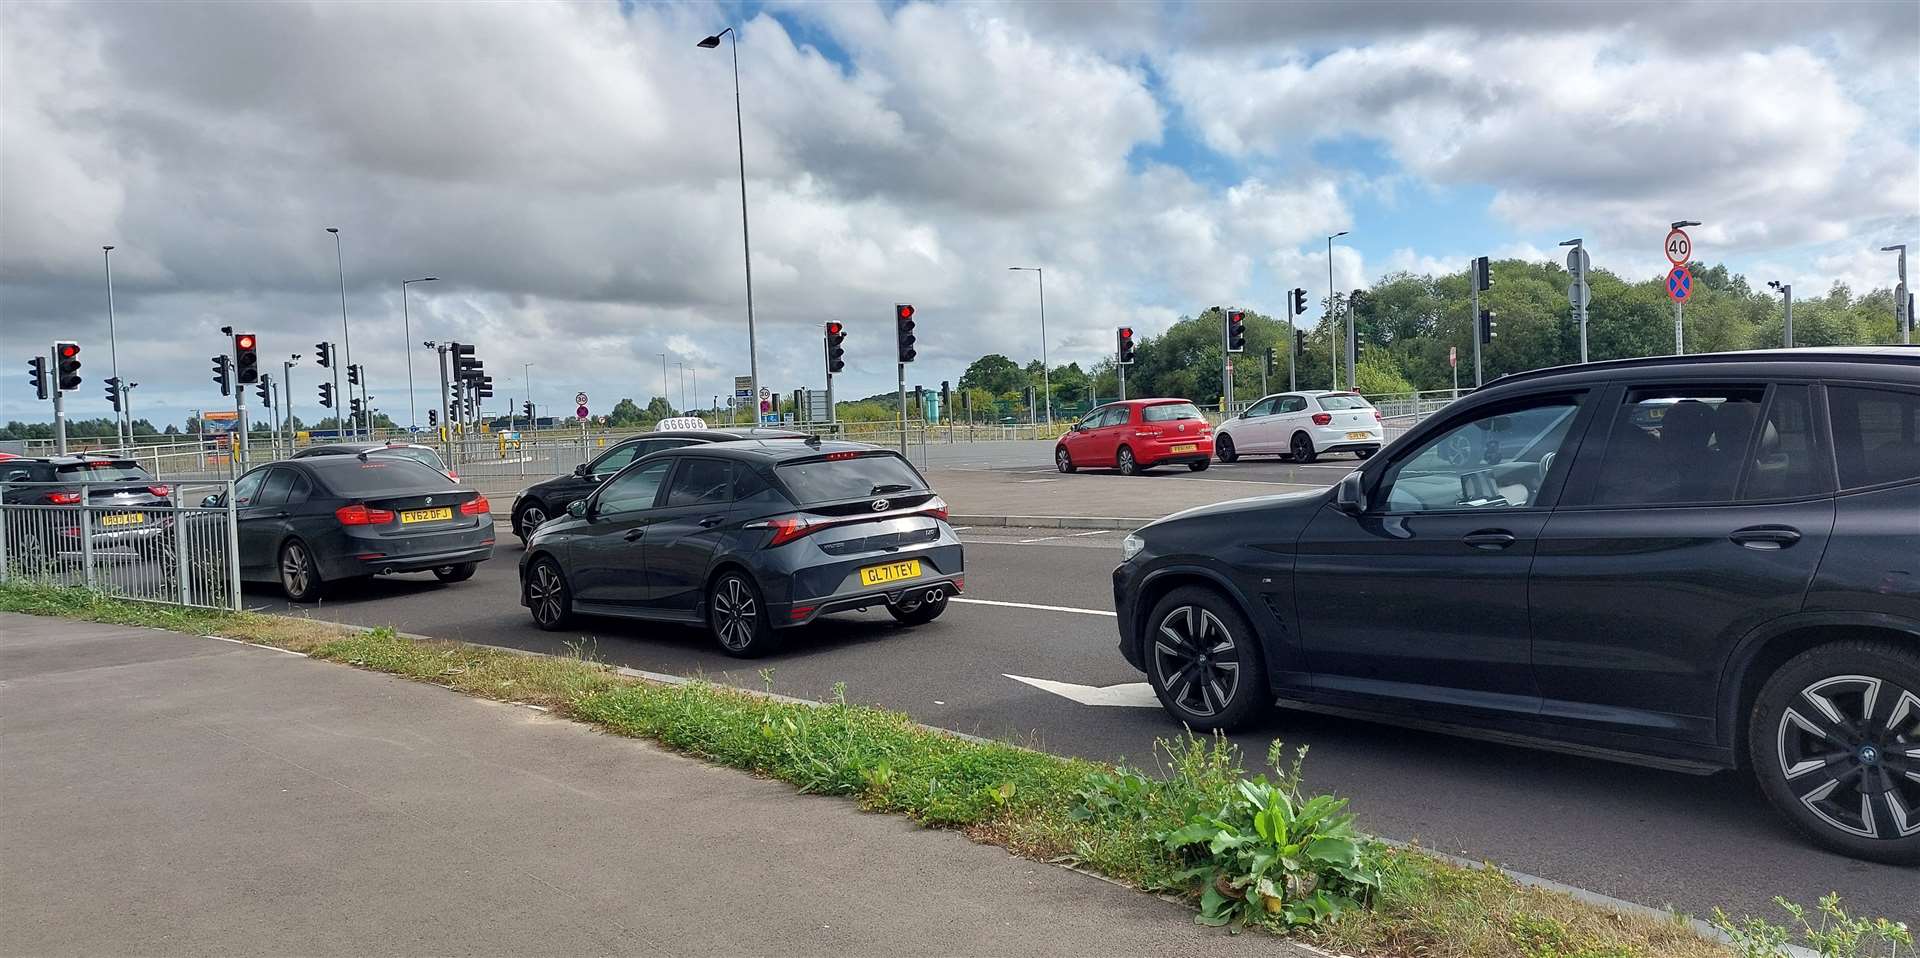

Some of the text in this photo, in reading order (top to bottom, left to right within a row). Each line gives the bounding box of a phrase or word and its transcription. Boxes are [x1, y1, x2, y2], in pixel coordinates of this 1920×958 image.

[1669, 240, 1688, 255] 40
[663, 418, 704, 430] 666666
[404, 509, 448, 522] FV62 DFJ
[868, 562, 913, 582] GL71 TEY
